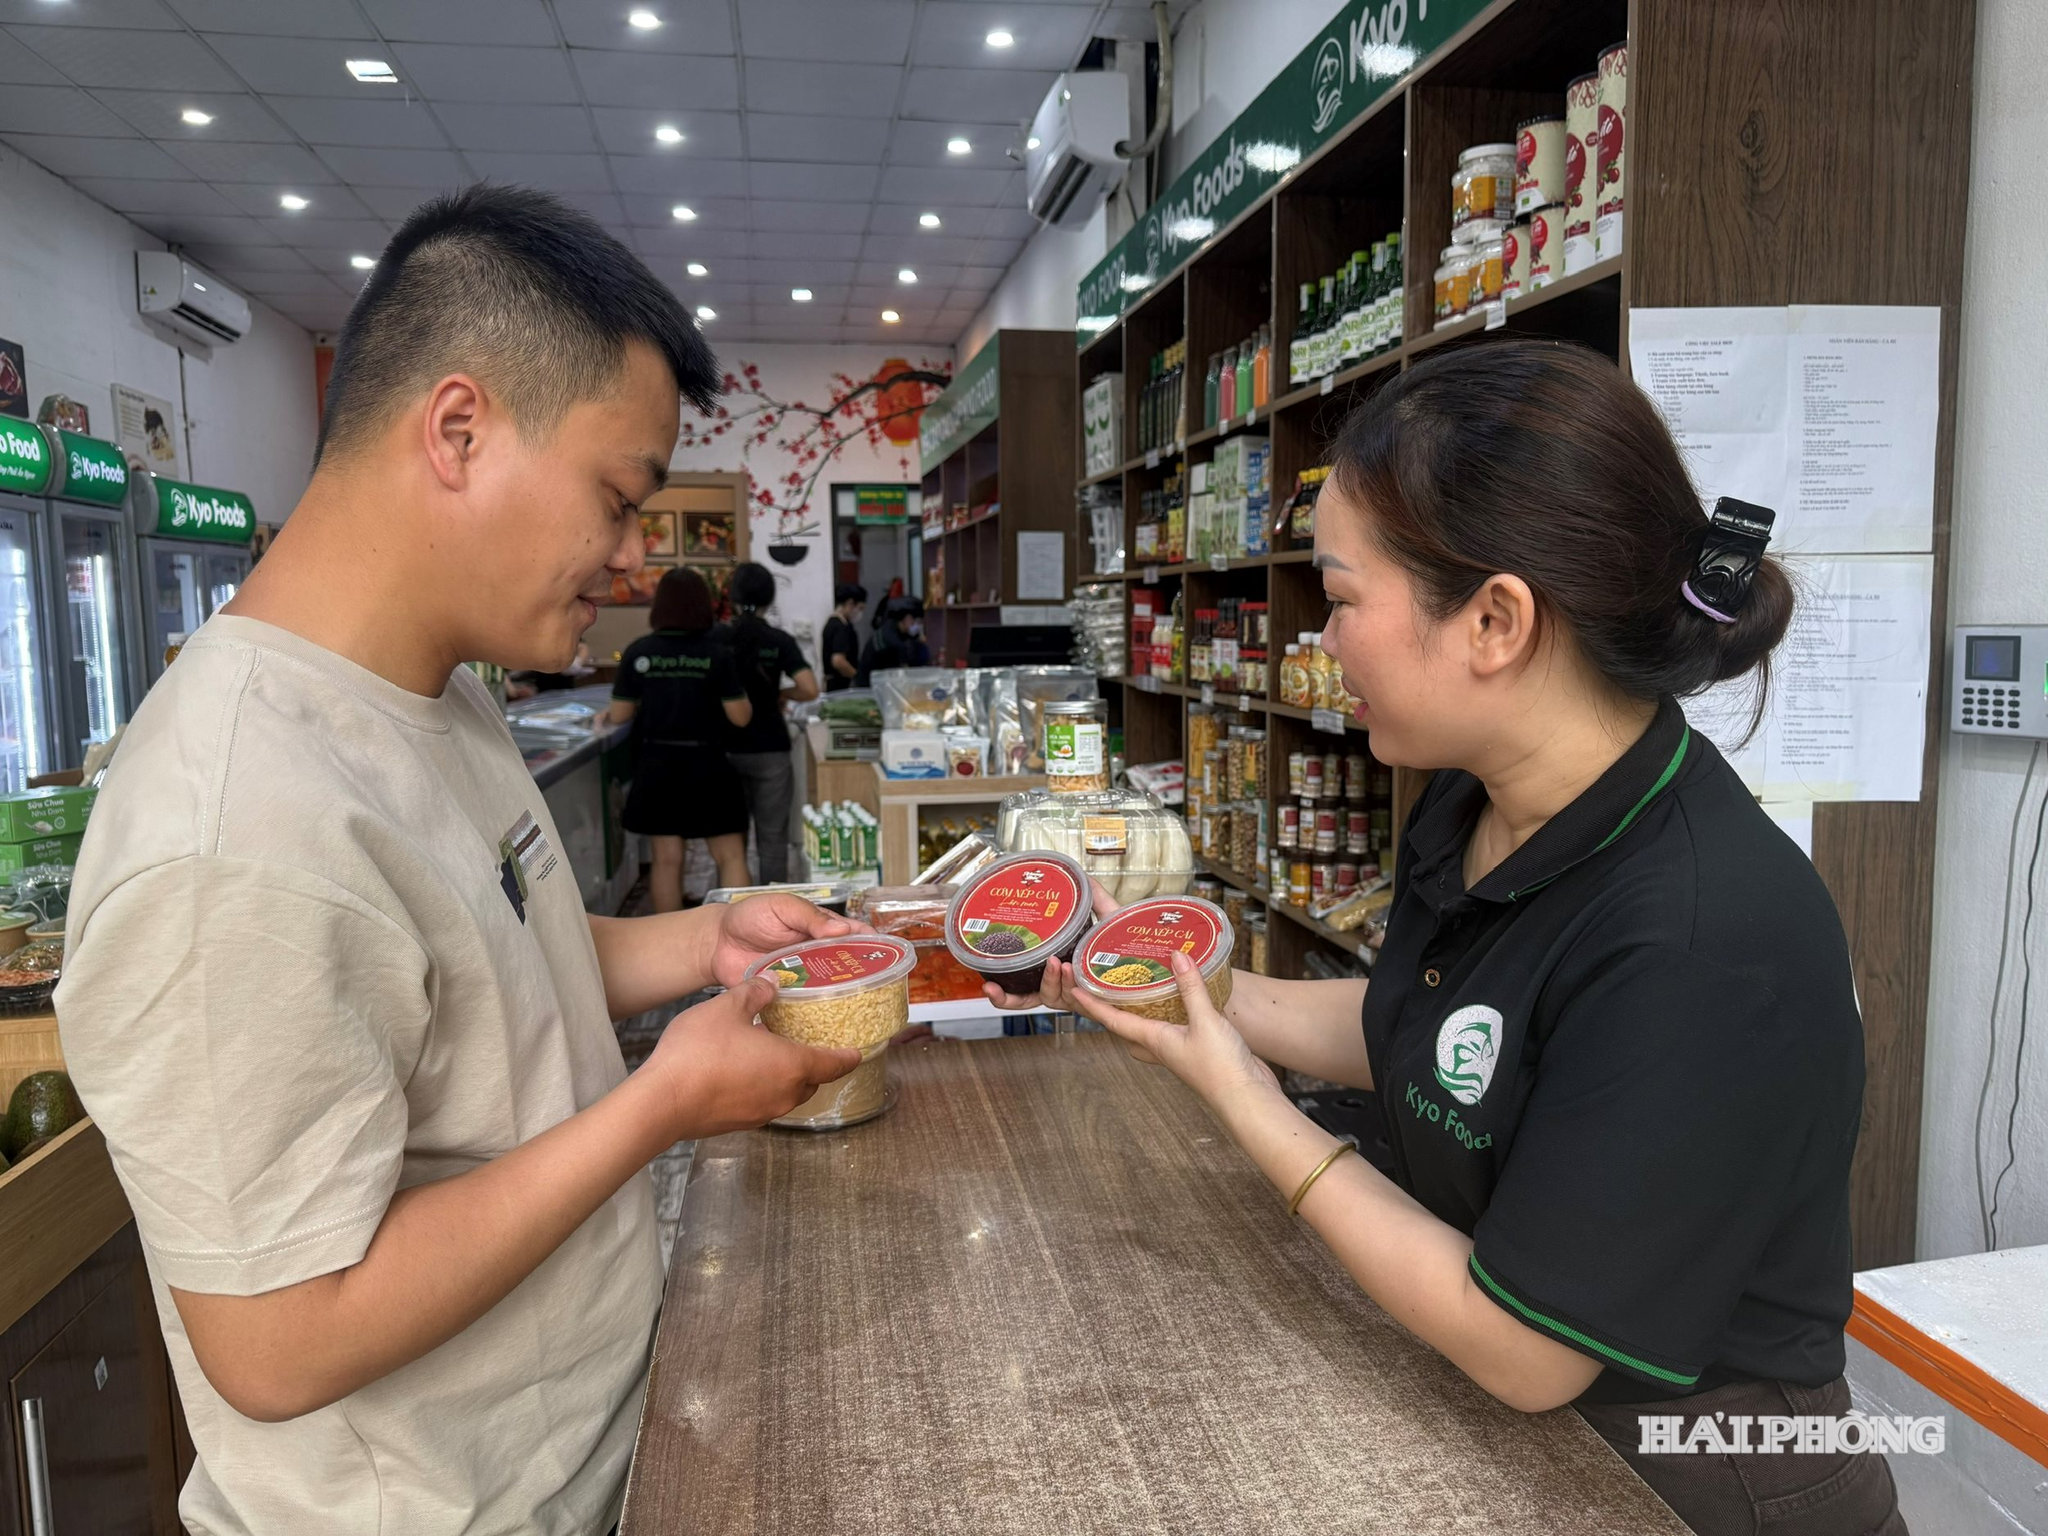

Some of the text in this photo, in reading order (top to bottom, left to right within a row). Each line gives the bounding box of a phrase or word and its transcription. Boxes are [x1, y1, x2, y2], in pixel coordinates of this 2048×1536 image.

[1192, 137, 1245, 222] Foods
[7, 431, 41, 462] Food
[82, 456, 125, 485] Kyo Foods
[187, 493, 247, 529] Kyo Foods
[1406, 1081, 1493, 1150] Kyo Food
